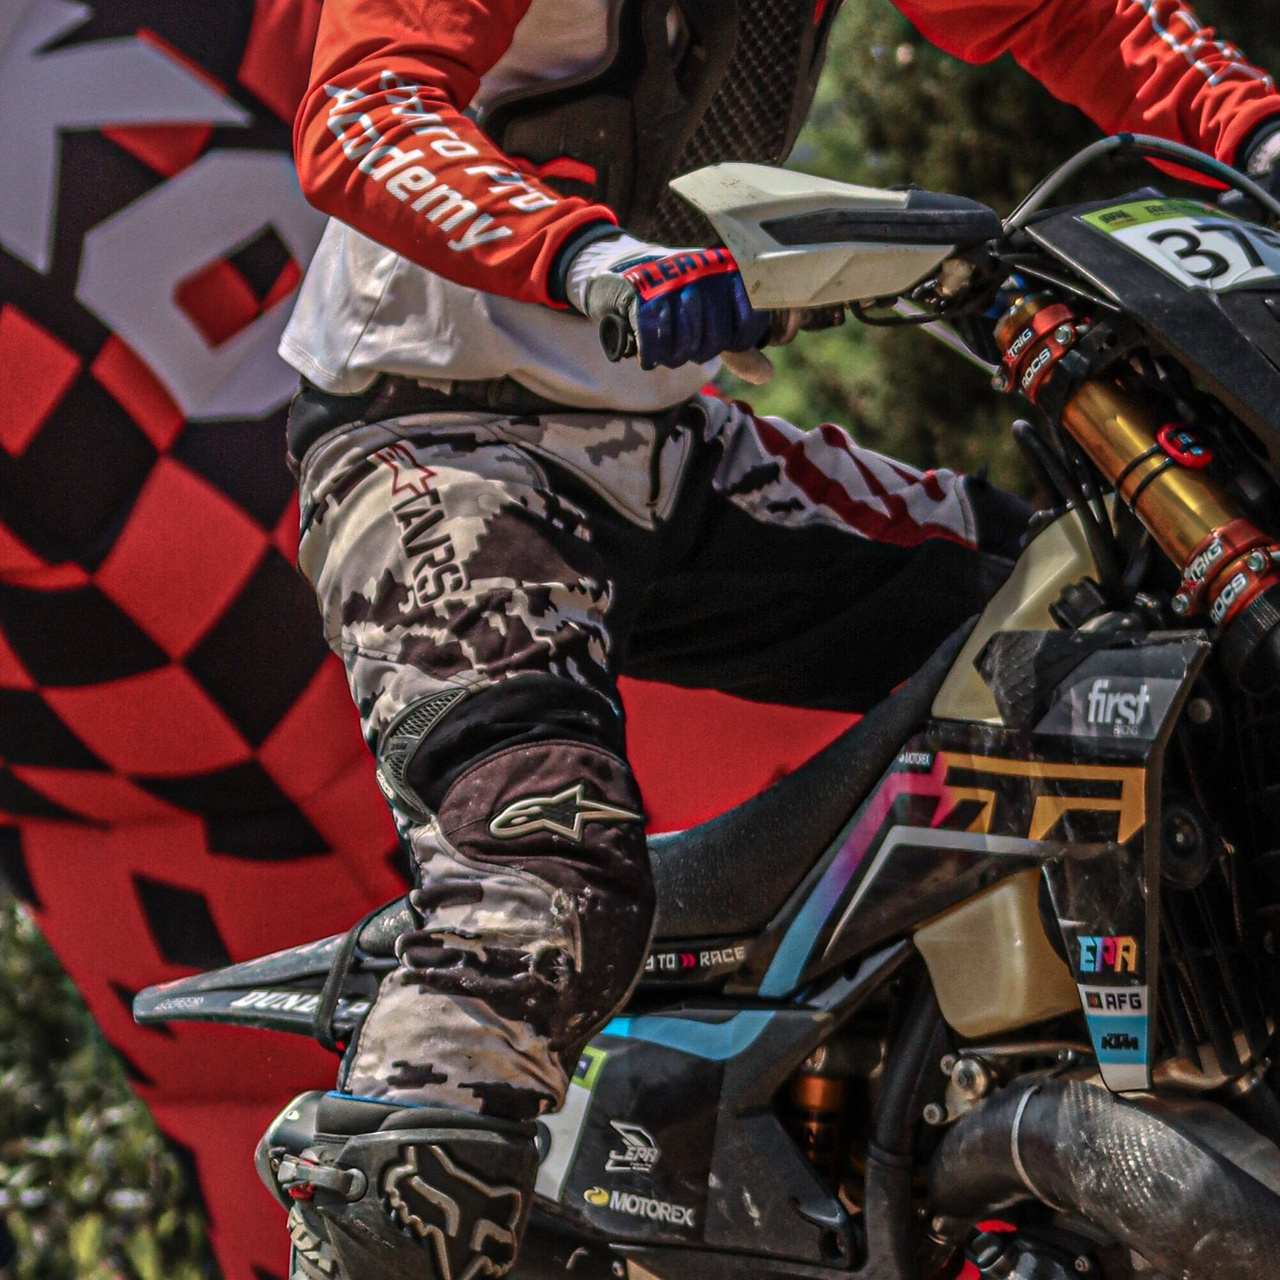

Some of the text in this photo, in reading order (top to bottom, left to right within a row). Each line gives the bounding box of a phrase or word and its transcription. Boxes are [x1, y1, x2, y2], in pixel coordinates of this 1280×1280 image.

[322, 82, 513, 252] Academy
[463, 164, 559, 213] Pro
[1087, 678, 1151, 725] first
[657, 952, 677, 970] TO
[699, 946, 746, 968] RACE
[229, 989, 371, 1016] DUNLP
[1105, 993, 1142, 1011] AFG
[1100, 1032, 1140, 1051] KTM
[609, 1190, 696, 1228] MOTOREX
